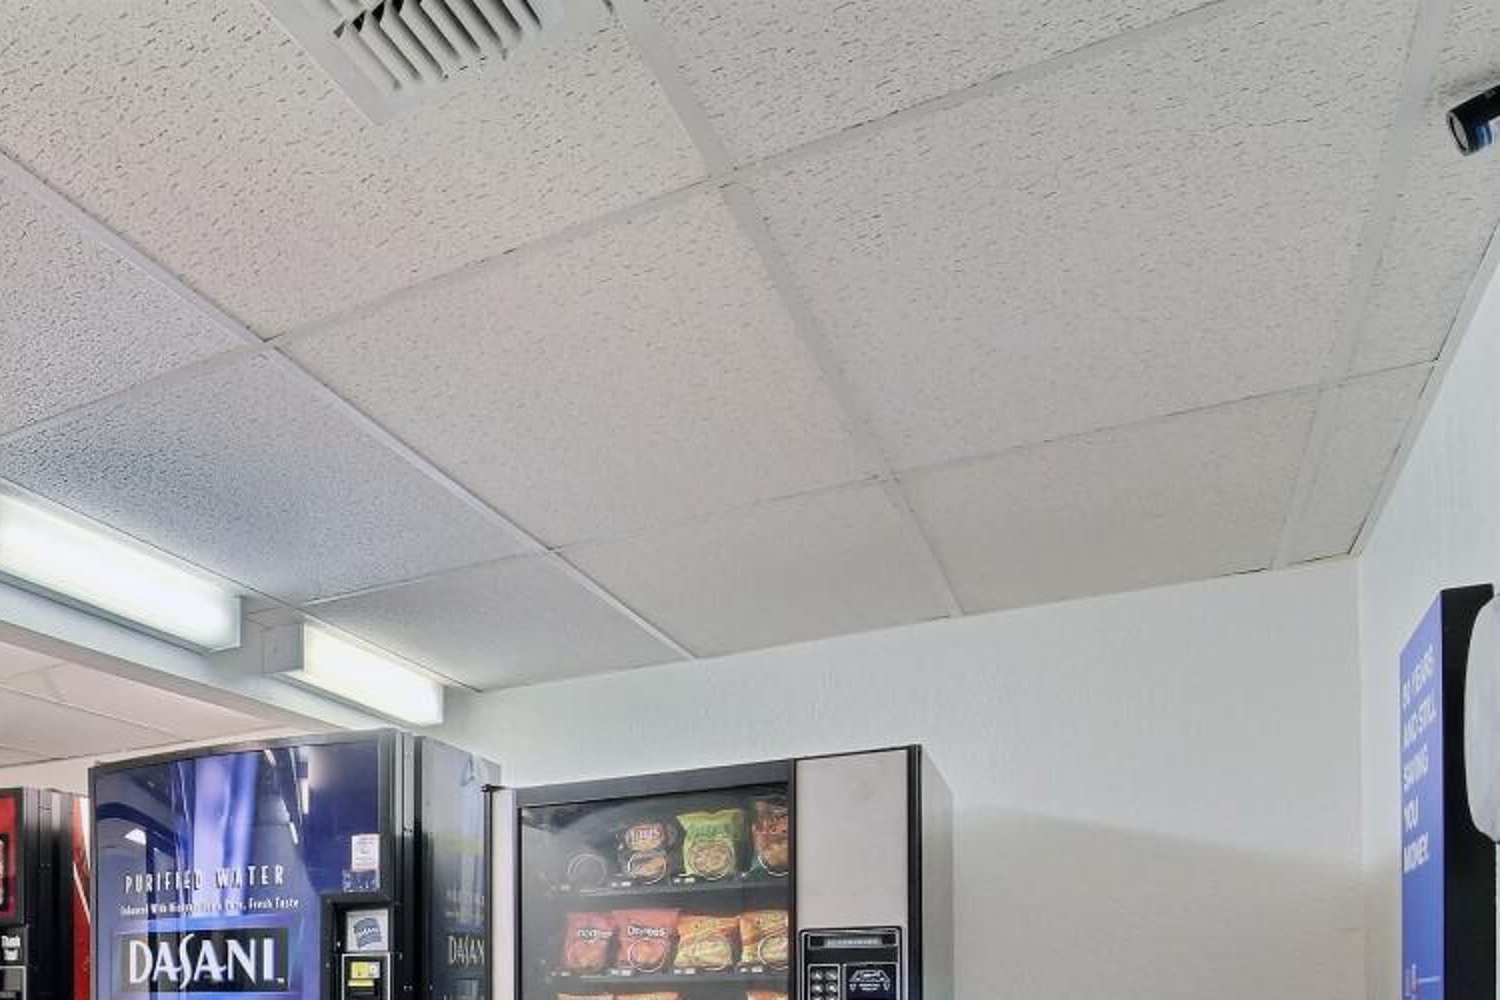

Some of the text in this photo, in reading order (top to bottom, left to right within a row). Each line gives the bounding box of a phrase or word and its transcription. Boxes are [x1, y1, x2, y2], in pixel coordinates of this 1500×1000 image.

[125, 865, 285, 895] PURIFIED WATER
[275, 897, 300, 909] Taste
[129, 933, 275, 990] DASANI
[448, 935, 485, 968] DASAN
